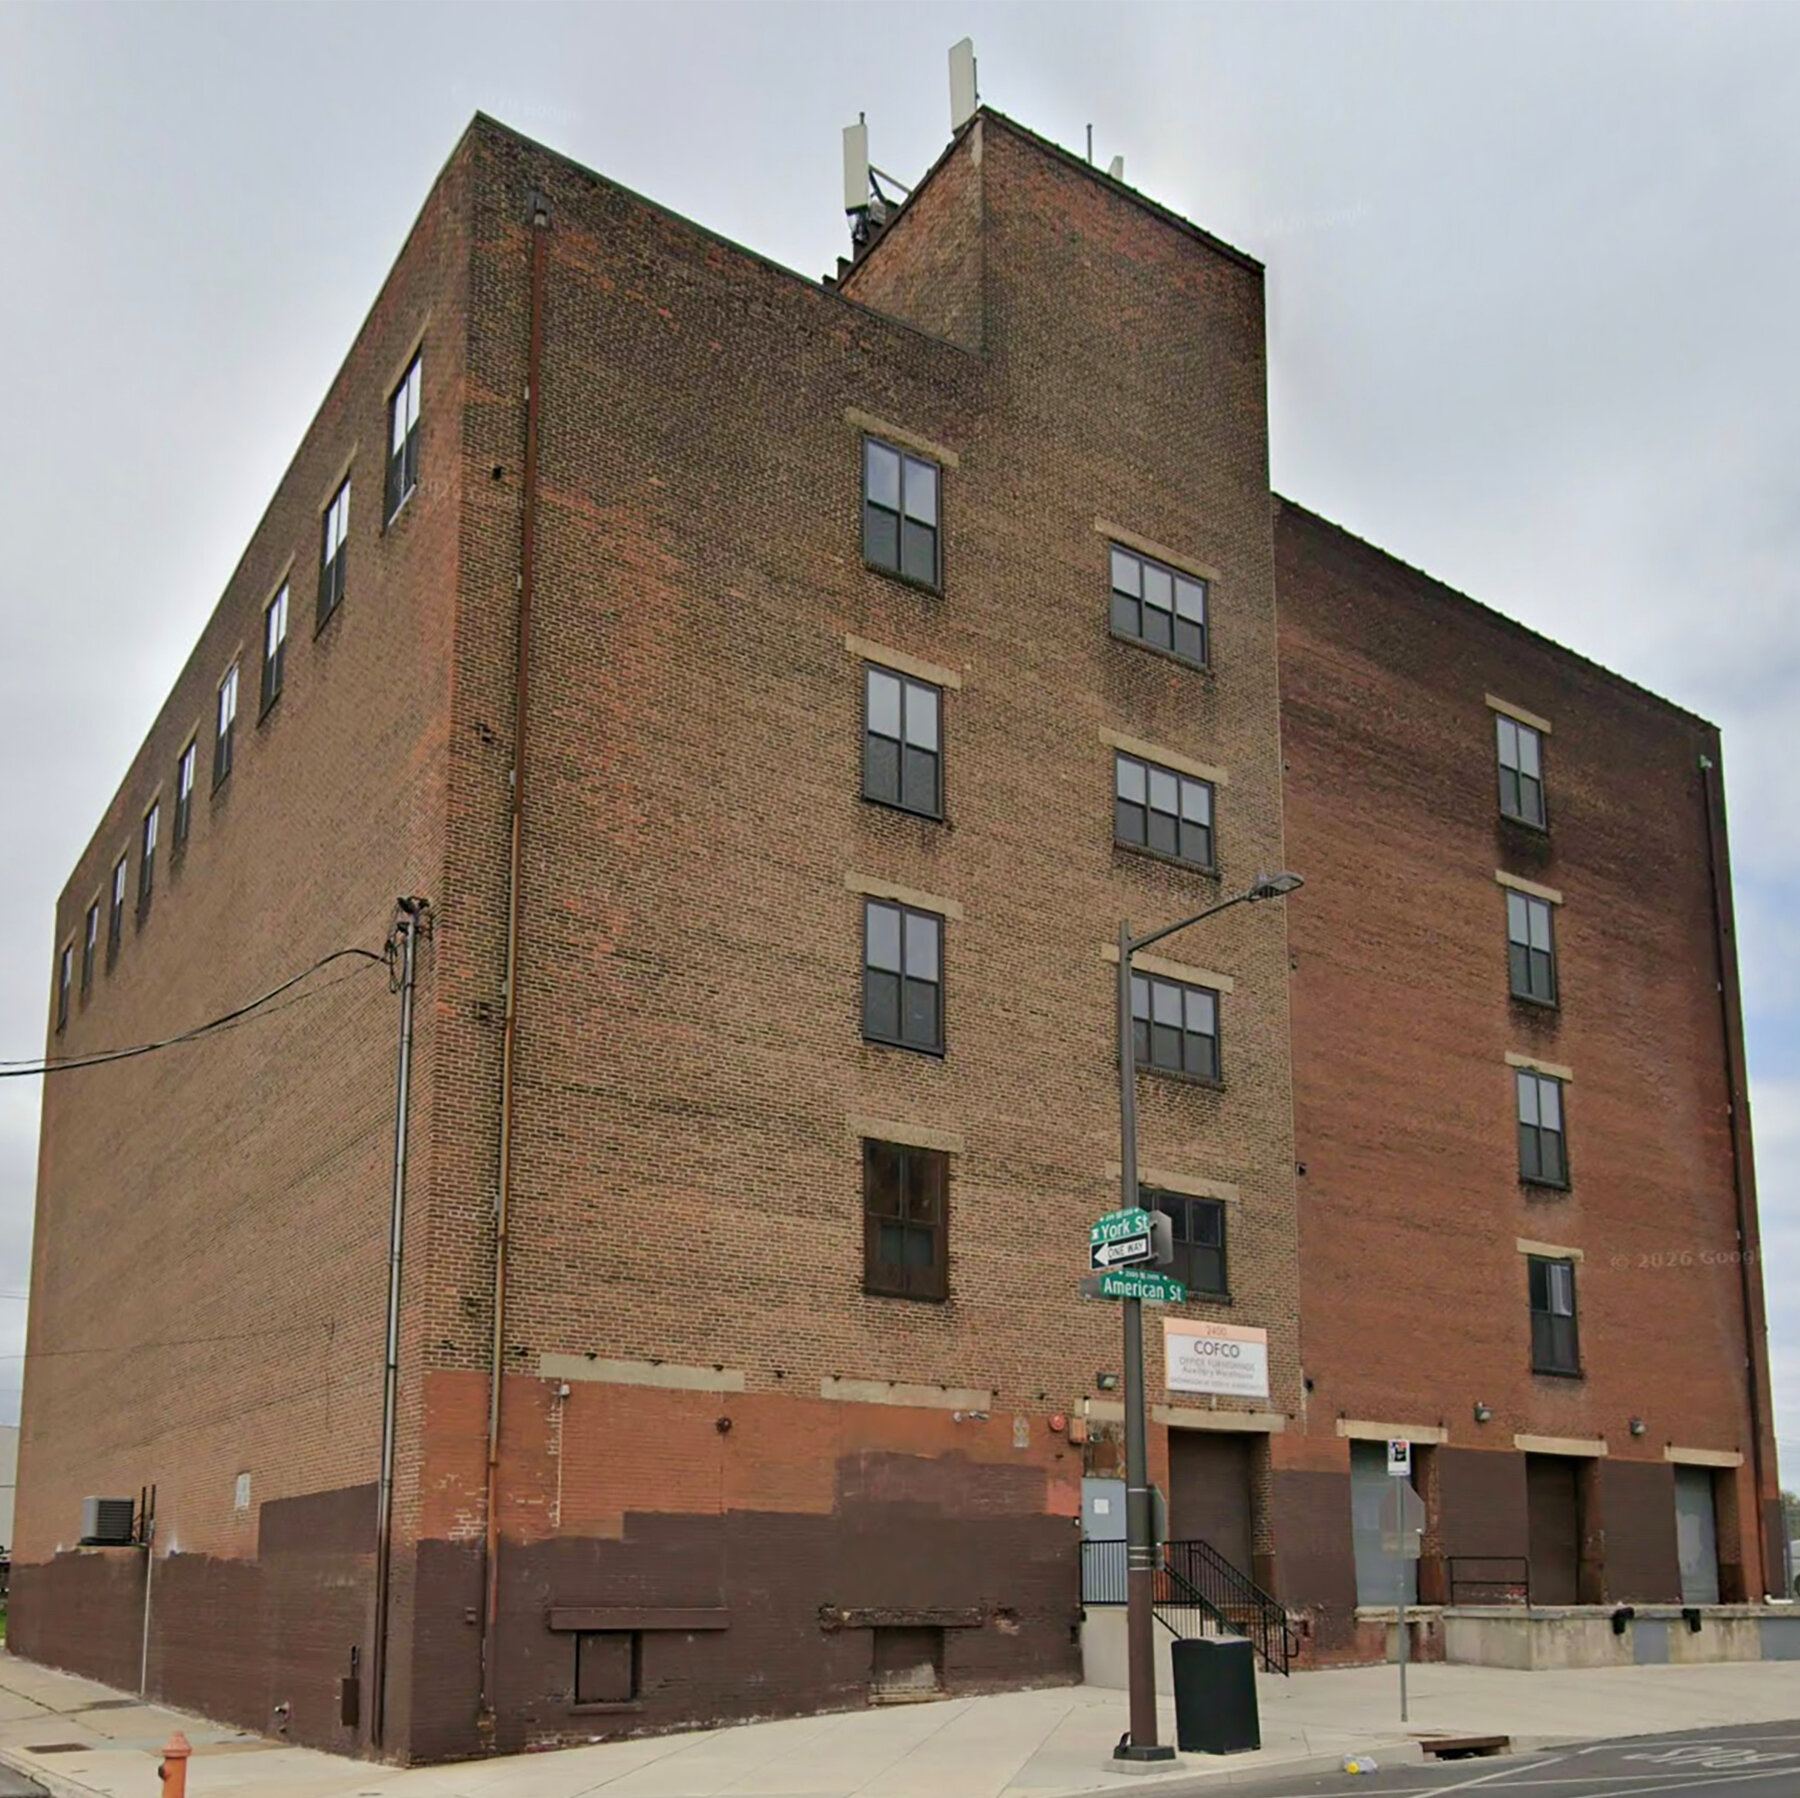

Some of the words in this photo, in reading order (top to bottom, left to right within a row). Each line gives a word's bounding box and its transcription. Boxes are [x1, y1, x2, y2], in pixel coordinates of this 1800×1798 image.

[1101, 1219, 1131, 1239] York
[1135, 1215, 1149, 1232] St
[1107, 1245, 1126, 1258] ONE
[1127, 1240, 1144, 1253] WAY
[1103, 1277, 1164, 1299] American
[1169, 1285, 1182, 1301] St
[1194, 1340, 1240, 1358] COFCO
